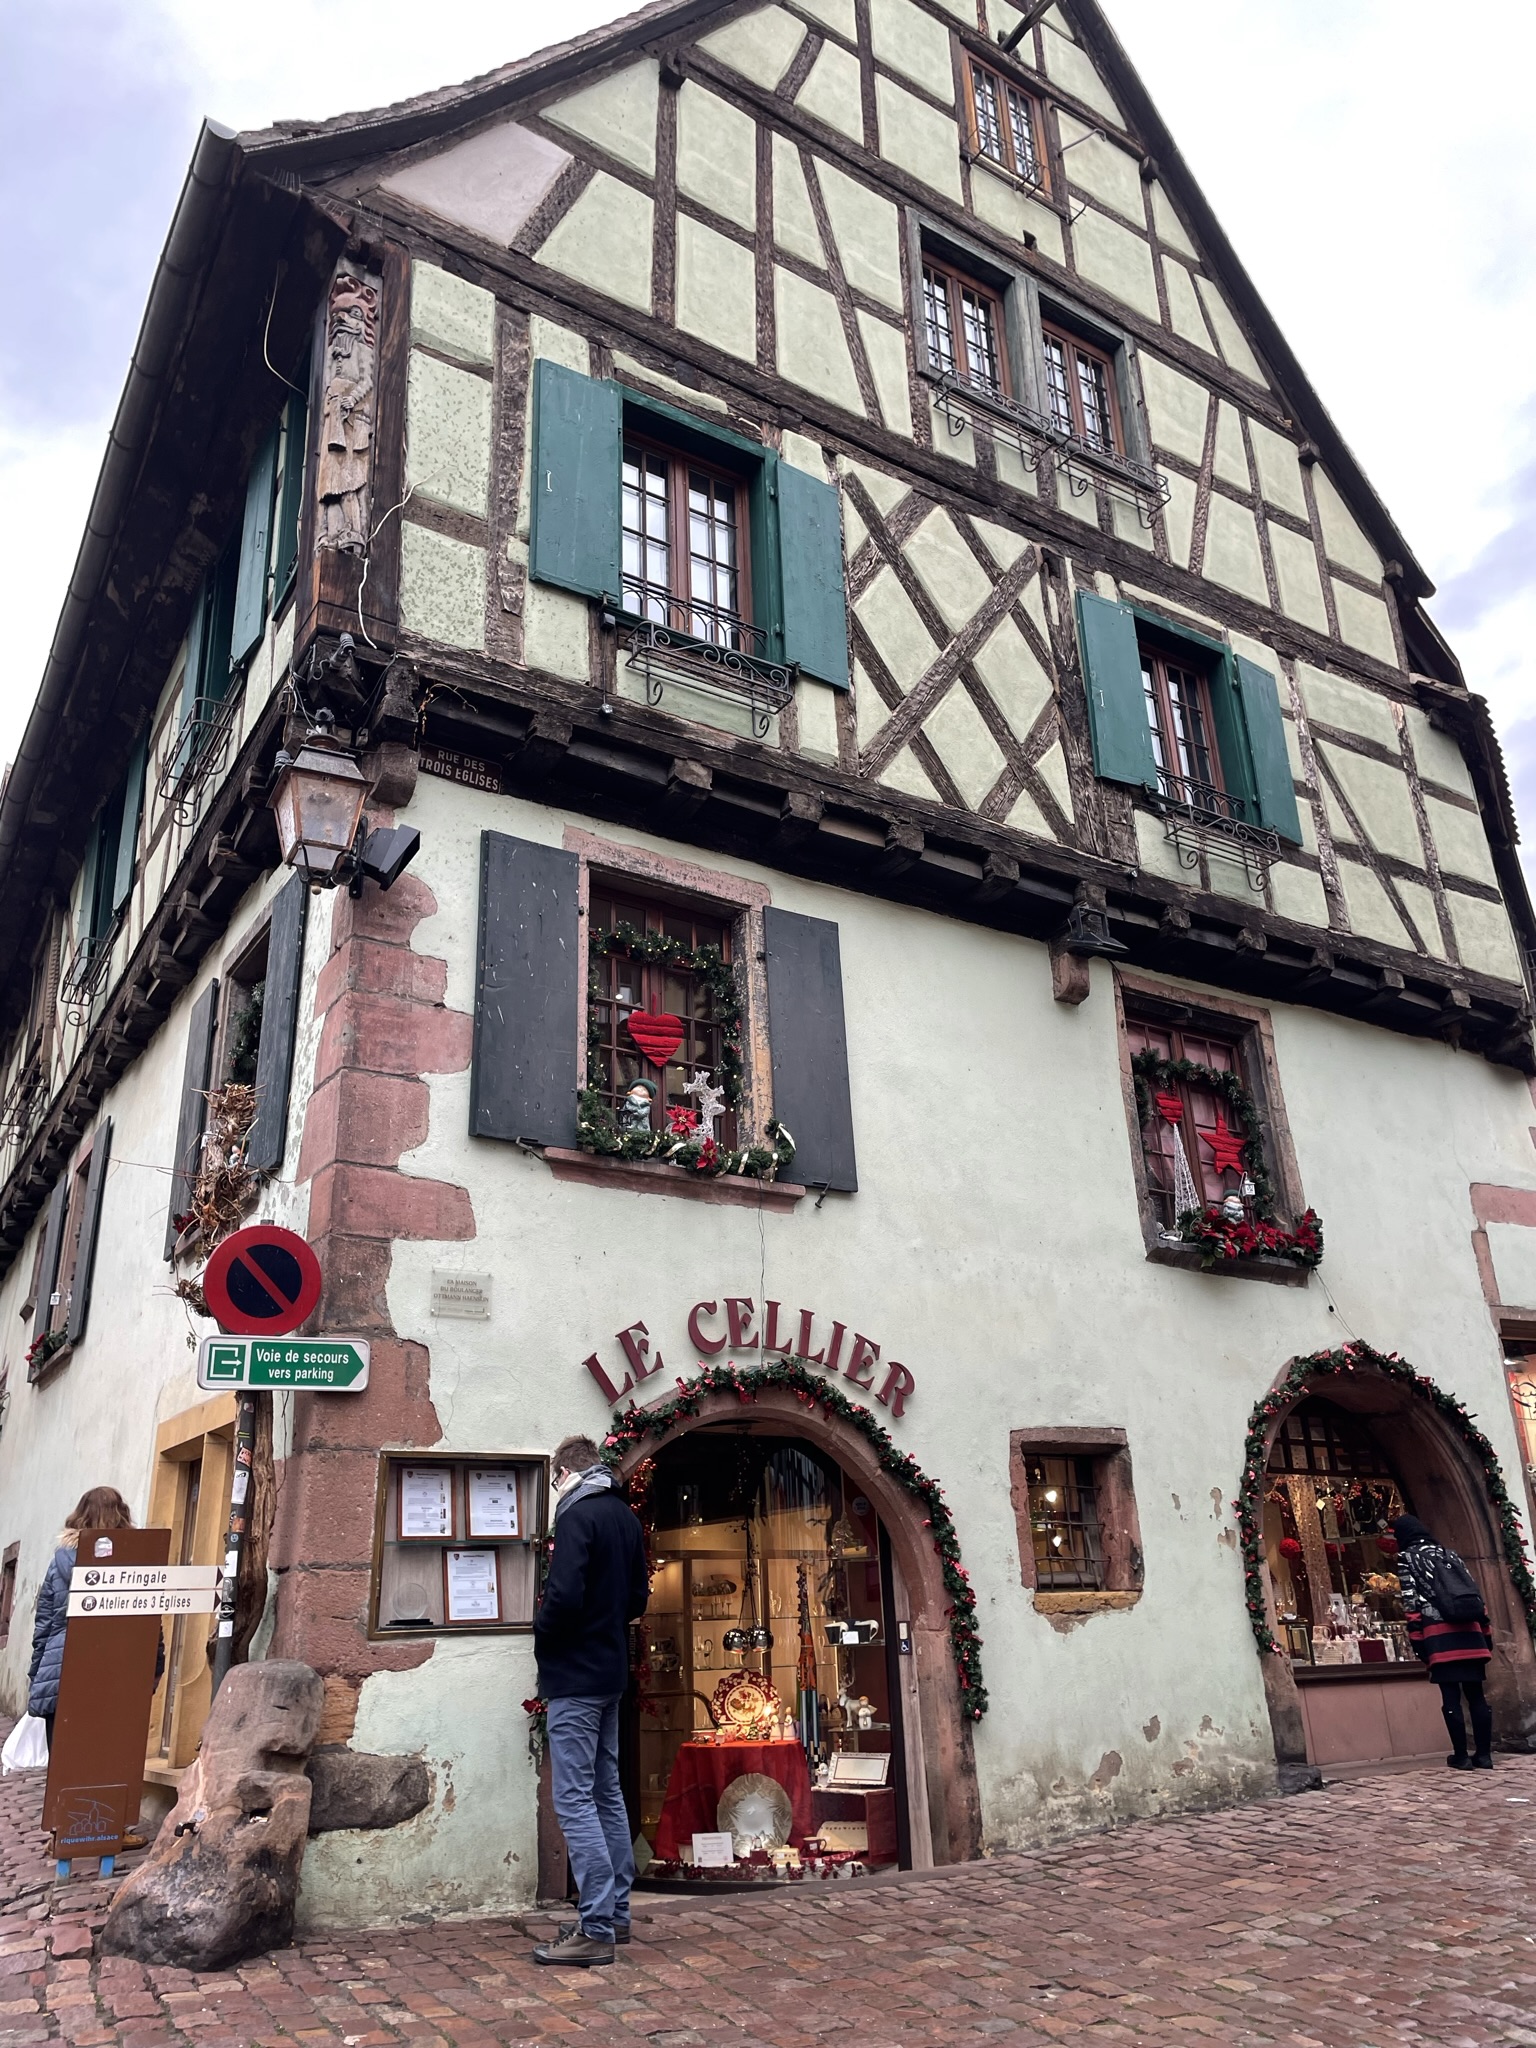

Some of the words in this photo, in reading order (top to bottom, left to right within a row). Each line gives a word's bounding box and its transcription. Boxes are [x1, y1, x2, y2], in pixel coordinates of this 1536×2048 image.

[420, 758, 452, 776] TROIS
[438, 750, 460, 764] RUE
[464, 758, 486, 772] DES
[256, 1348, 281, 1363] Voie
[285, 1350, 299, 1363] de
[303, 1351, 349, 1364] secours
[582, 1320, 664, 1407] LE
[688, 1297, 916, 1418] CELLIER
[268, 1367, 291, 1379] vers
[294, 1367, 334, 1382] parking
[102, 1571, 115, 1584] La
[120, 1571, 167, 1587] Fringale
[98, 1597, 129, 1610] Atelier
[132, 1595, 148, 1608] des
[151, 1597, 156, 1608] 3
[159, 1592, 191, 1611] Églises
[60, 1834, 119, 1844] riquewihr.alsace
